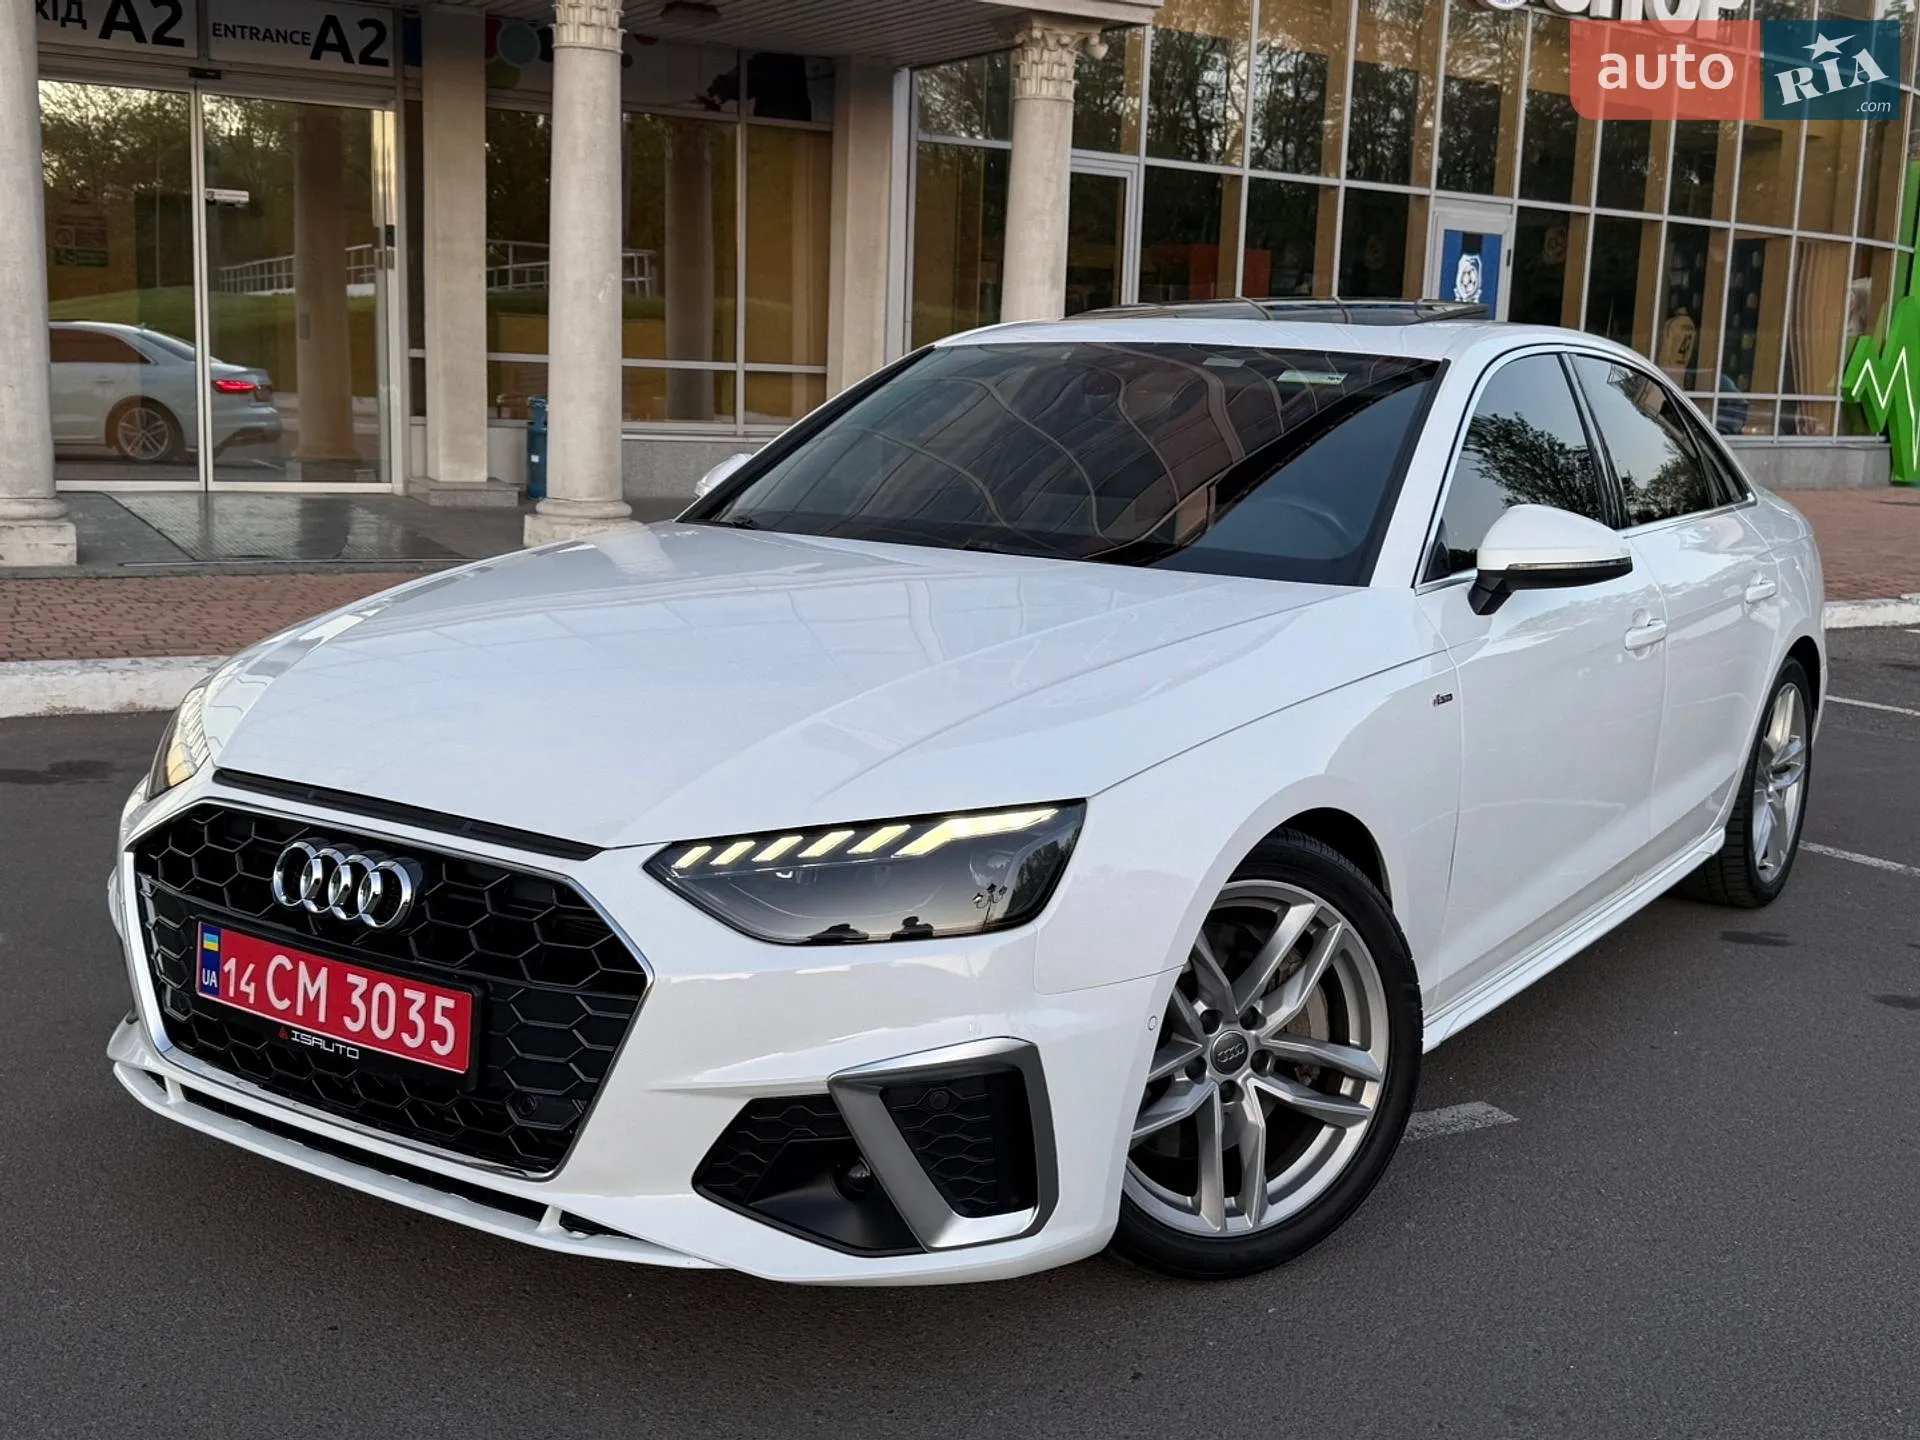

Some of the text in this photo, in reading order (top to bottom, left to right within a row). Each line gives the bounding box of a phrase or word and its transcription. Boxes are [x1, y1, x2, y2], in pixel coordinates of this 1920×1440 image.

[212, 14, 389, 67] ENTRANCE A2
[202, 967, 218, 988] UA
[223, 954, 456, 1056] 14 CM 3035
